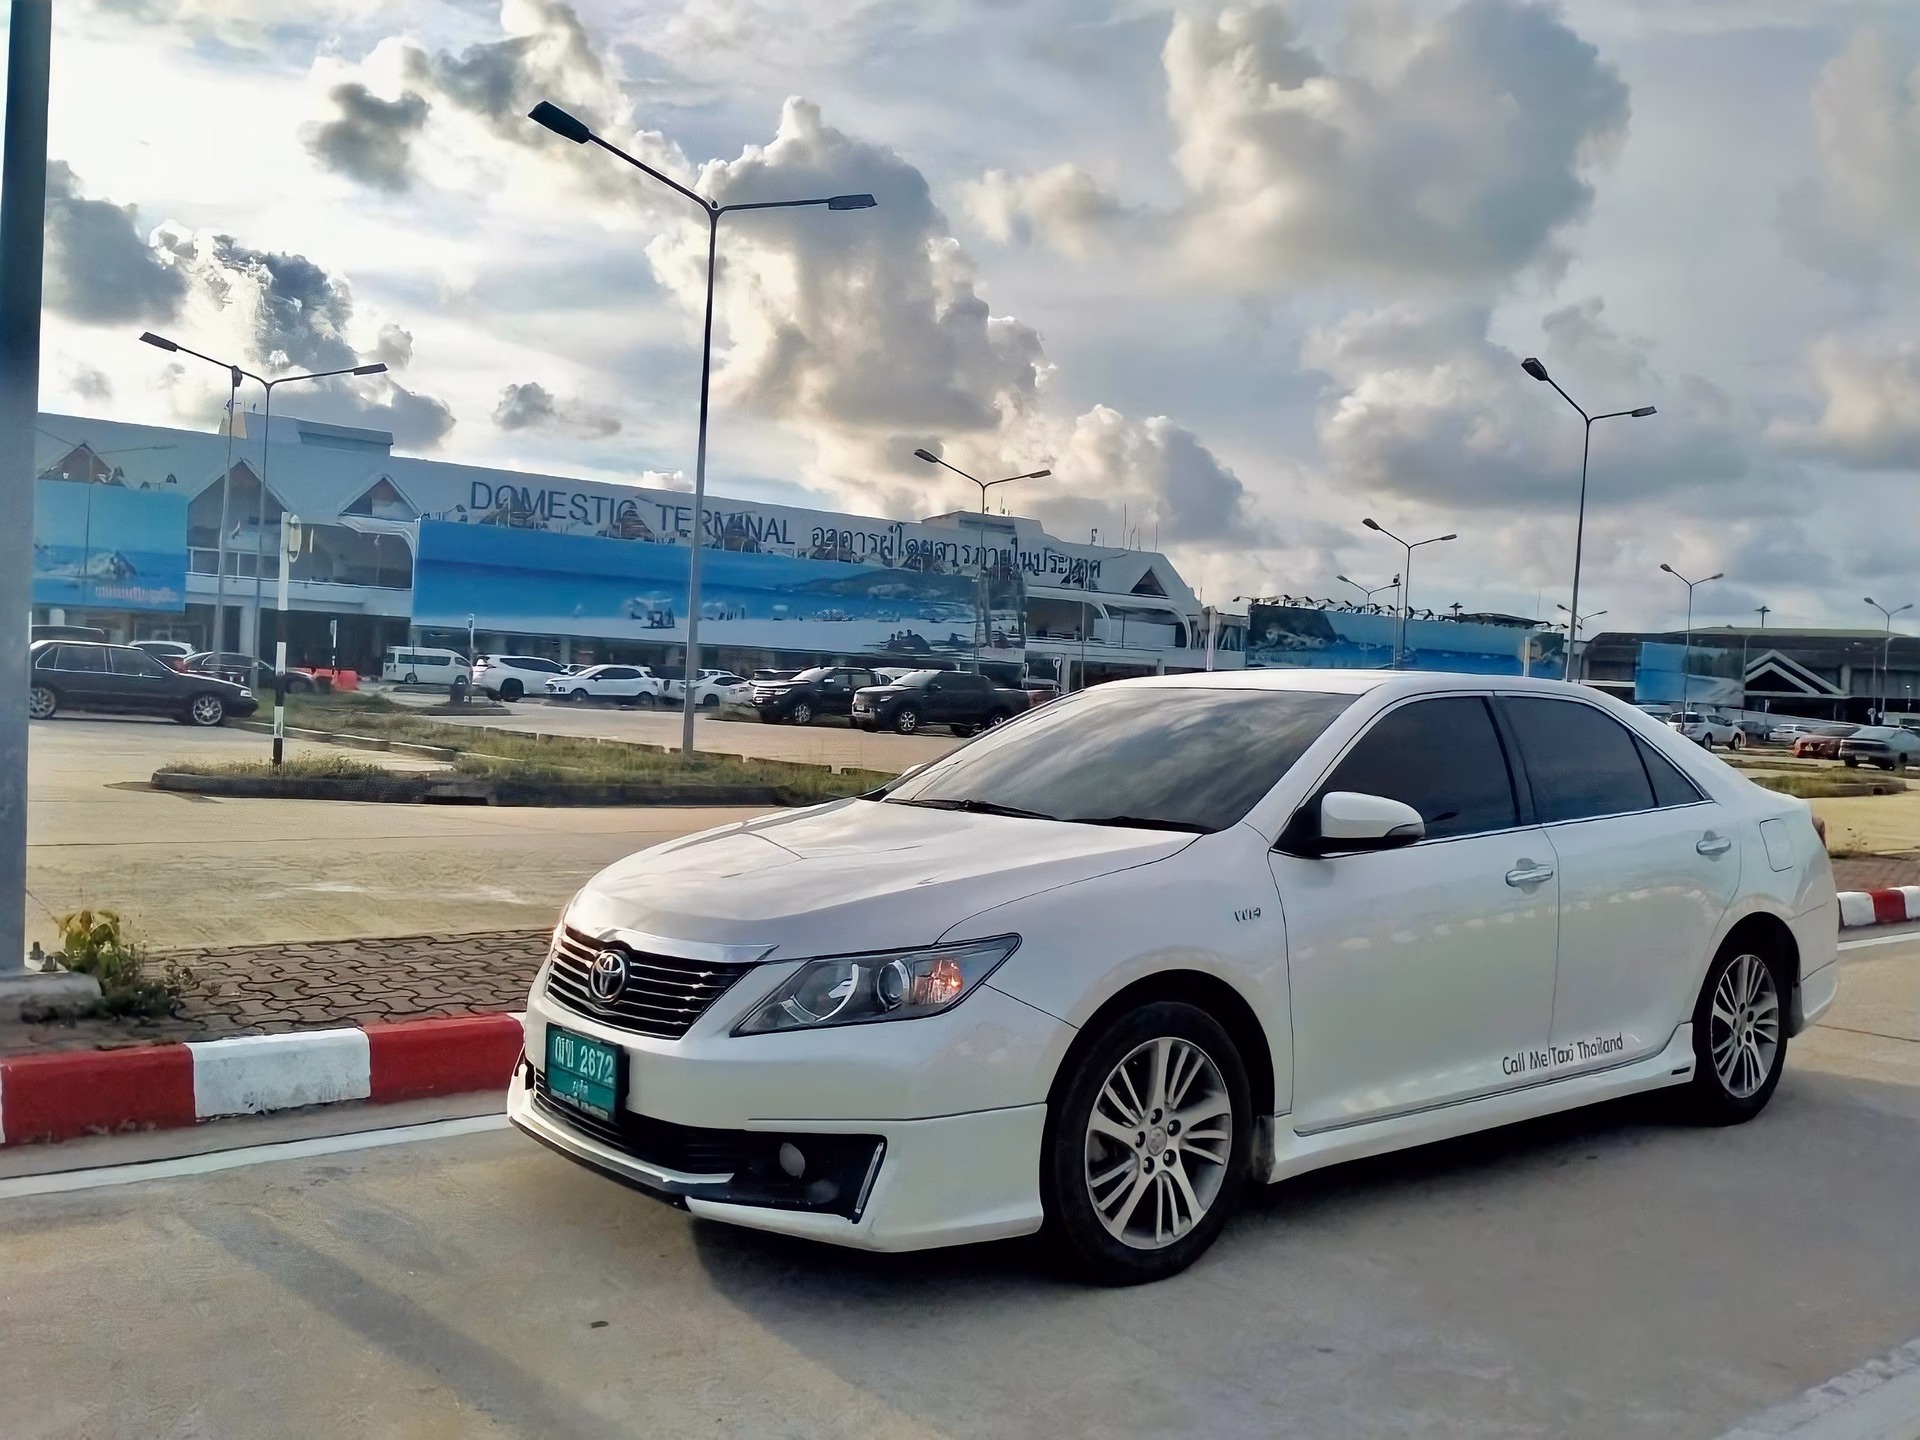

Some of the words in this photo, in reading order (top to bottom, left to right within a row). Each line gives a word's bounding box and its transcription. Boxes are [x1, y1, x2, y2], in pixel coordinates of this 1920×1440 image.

[471, 481, 637, 526] DOMESTIC
[1502, 1051, 1526, 1075] Call
[1529, 1051, 1549, 1070] Me
[1549, 1043, 1574, 1066] Taxi
